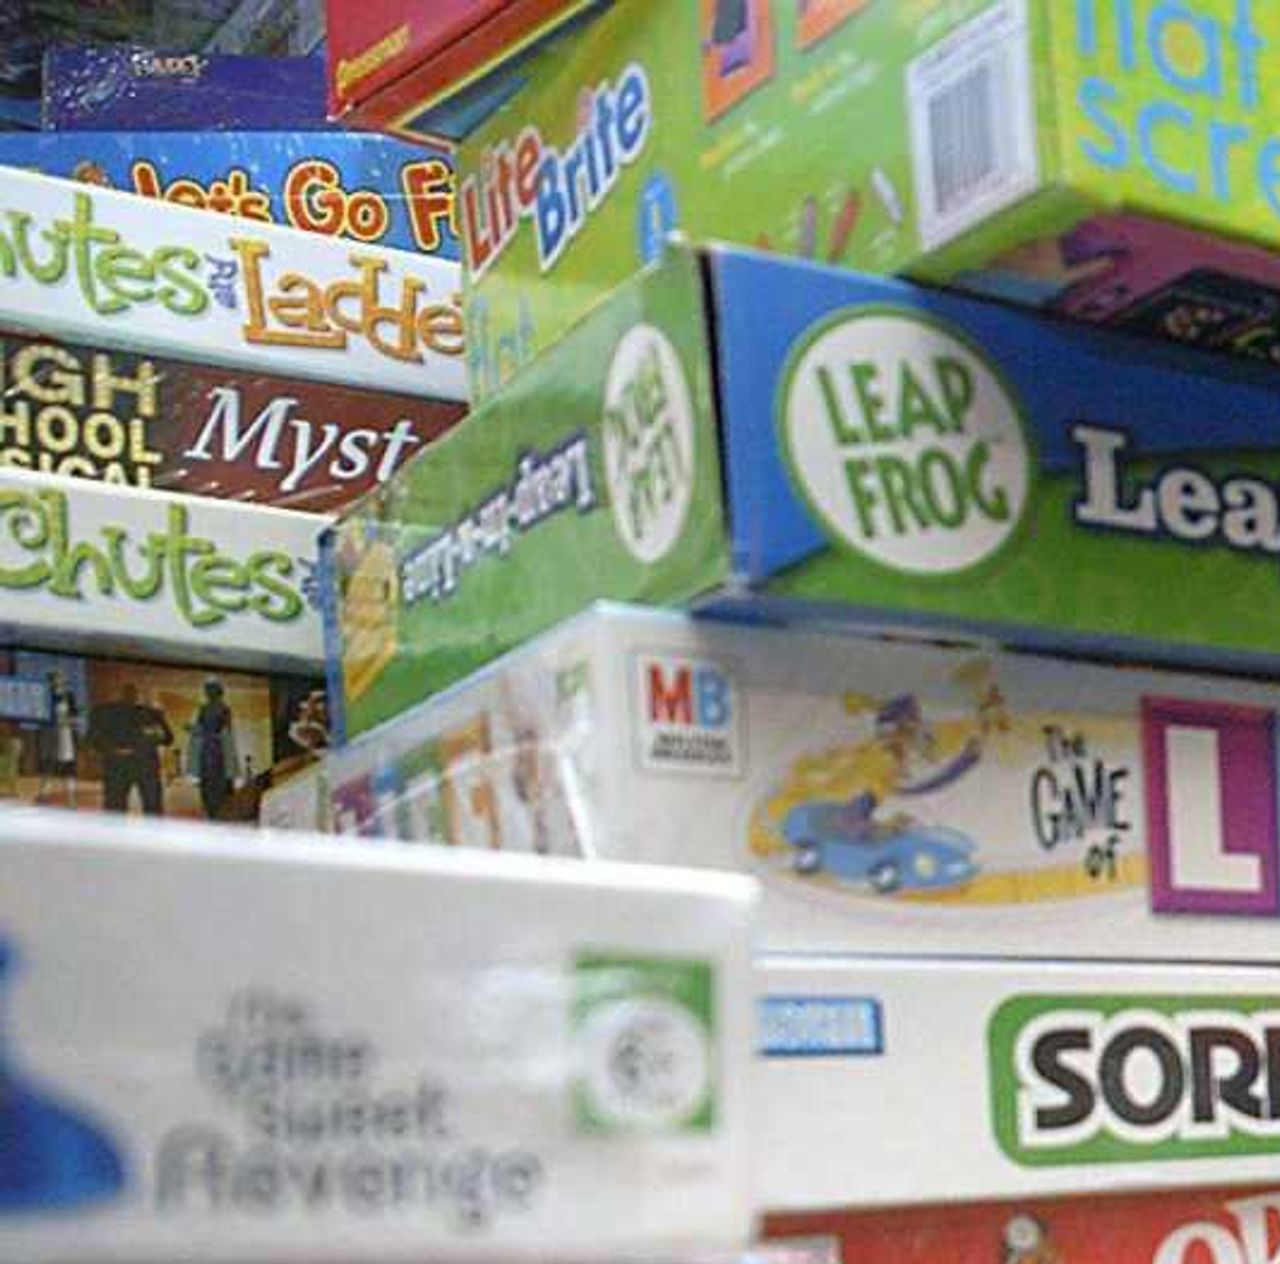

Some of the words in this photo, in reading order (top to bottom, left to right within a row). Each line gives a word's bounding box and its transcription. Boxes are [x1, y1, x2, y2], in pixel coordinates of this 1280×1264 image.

[284, 159, 389, 242] Go
[460, 127, 542, 282] Lite
[533, 63, 656, 274] Brite
[817, 357, 976, 446] LEAP
[842, 440, 1010, 539] FROG
[0, 488, 308, 628] Chutes
[649, 663, 733, 730] MB
[1031, 761, 1129, 849] GAME
[153, 1128, 545, 1232] Revenge
